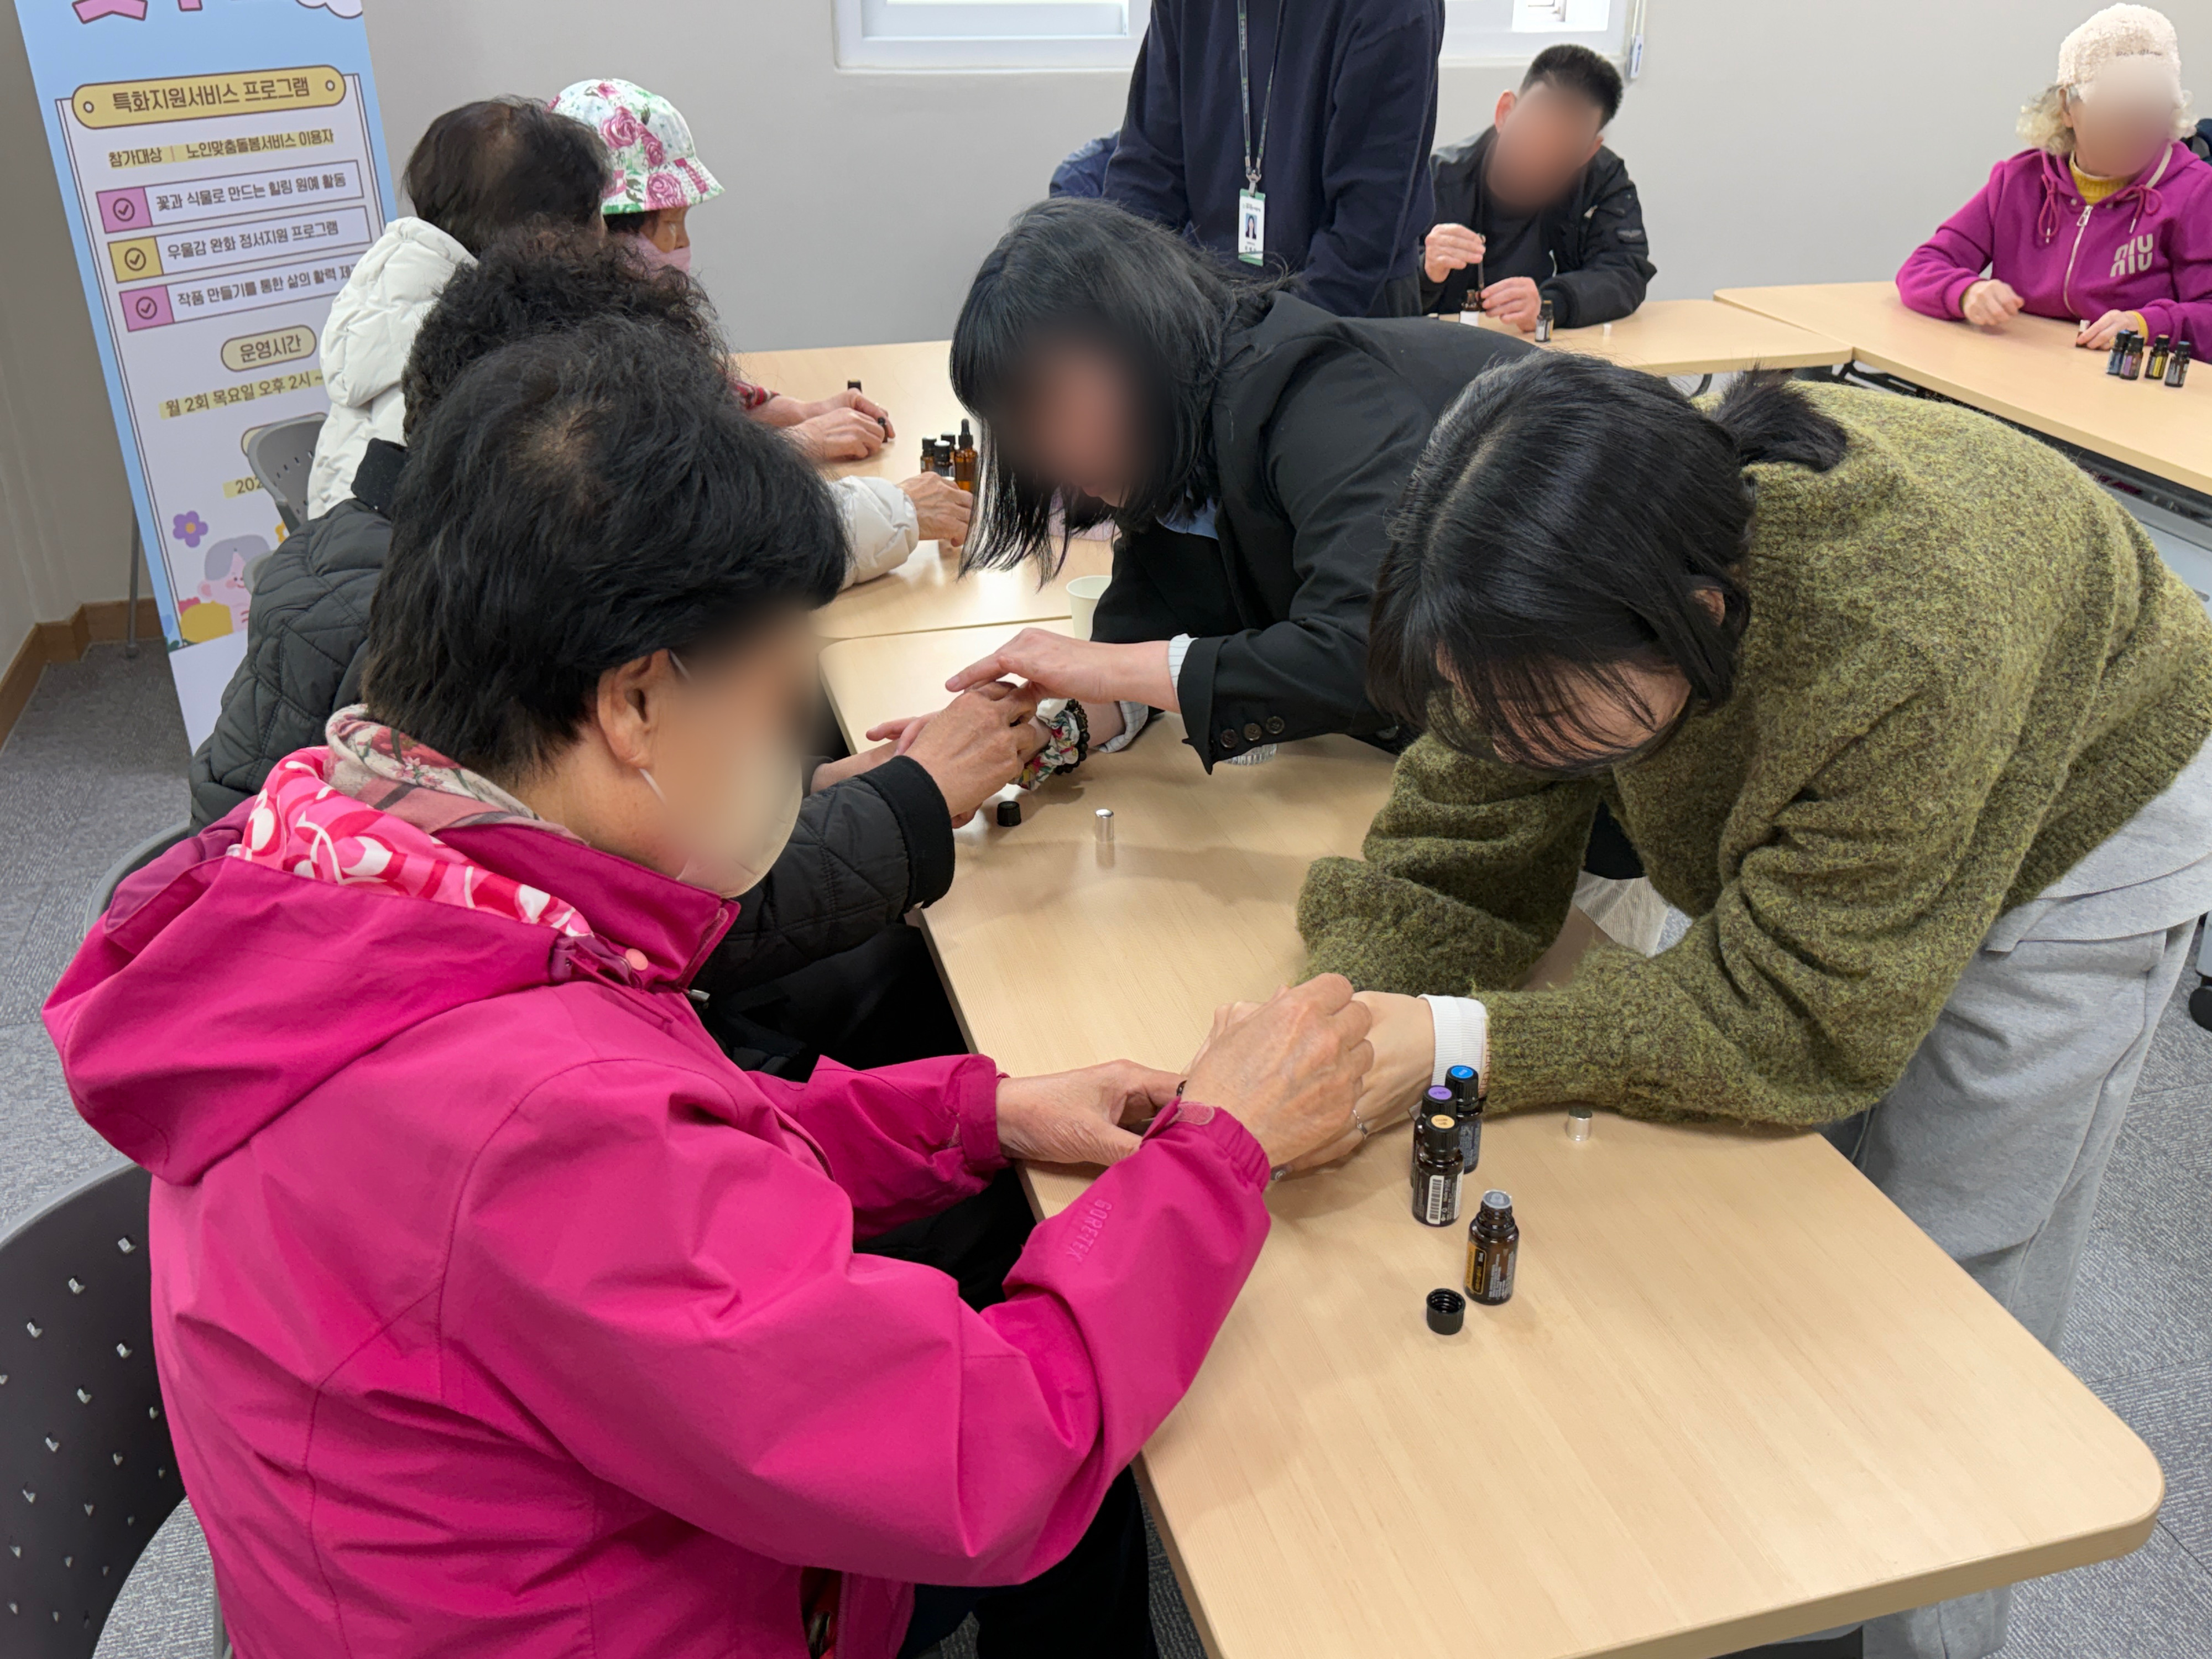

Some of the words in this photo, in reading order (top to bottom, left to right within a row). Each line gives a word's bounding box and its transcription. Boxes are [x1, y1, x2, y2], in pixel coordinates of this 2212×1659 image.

[113, 84, 239, 112] 특화지원서비스
[243, 77, 310, 102] 프로그램
[109, 147, 163, 167] 참가대상
[186, 133, 296, 159] 노인맞춤돌봄서비스
[299, 129, 333, 145] 이용자
[156, 194, 183, 211] 꽃과
[187, 189, 226, 206] 식물로
[228, 184, 265, 201] 만드는
[269, 179, 293, 196] 힐링
[296, 176, 319, 193] 원예
[322, 173, 346, 189] 활동
[168, 241, 206, 259] 우울감
[210, 236, 236, 253] 완화
[239, 228, 288, 249] 정서지원
[291, 221, 339, 241] 프로그램
[178, 290, 204, 307] 작품
[207, 281, 257, 302] 만들기를
[260, 276, 284, 294] 통한
[288, 272, 311, 289] 삶의
[313, 267, 336, 284] 활력
[339, 264, 356, 280] 제
[240, 334, 301, 363] 운영시간
[166, 399, 181, 417] 월
[185, 393, 210, 412] 2회
[213, 384, 255, 405] 목요일
[259, 378, 285, 396] 오후
[289, 371, 311, 390] 2시
